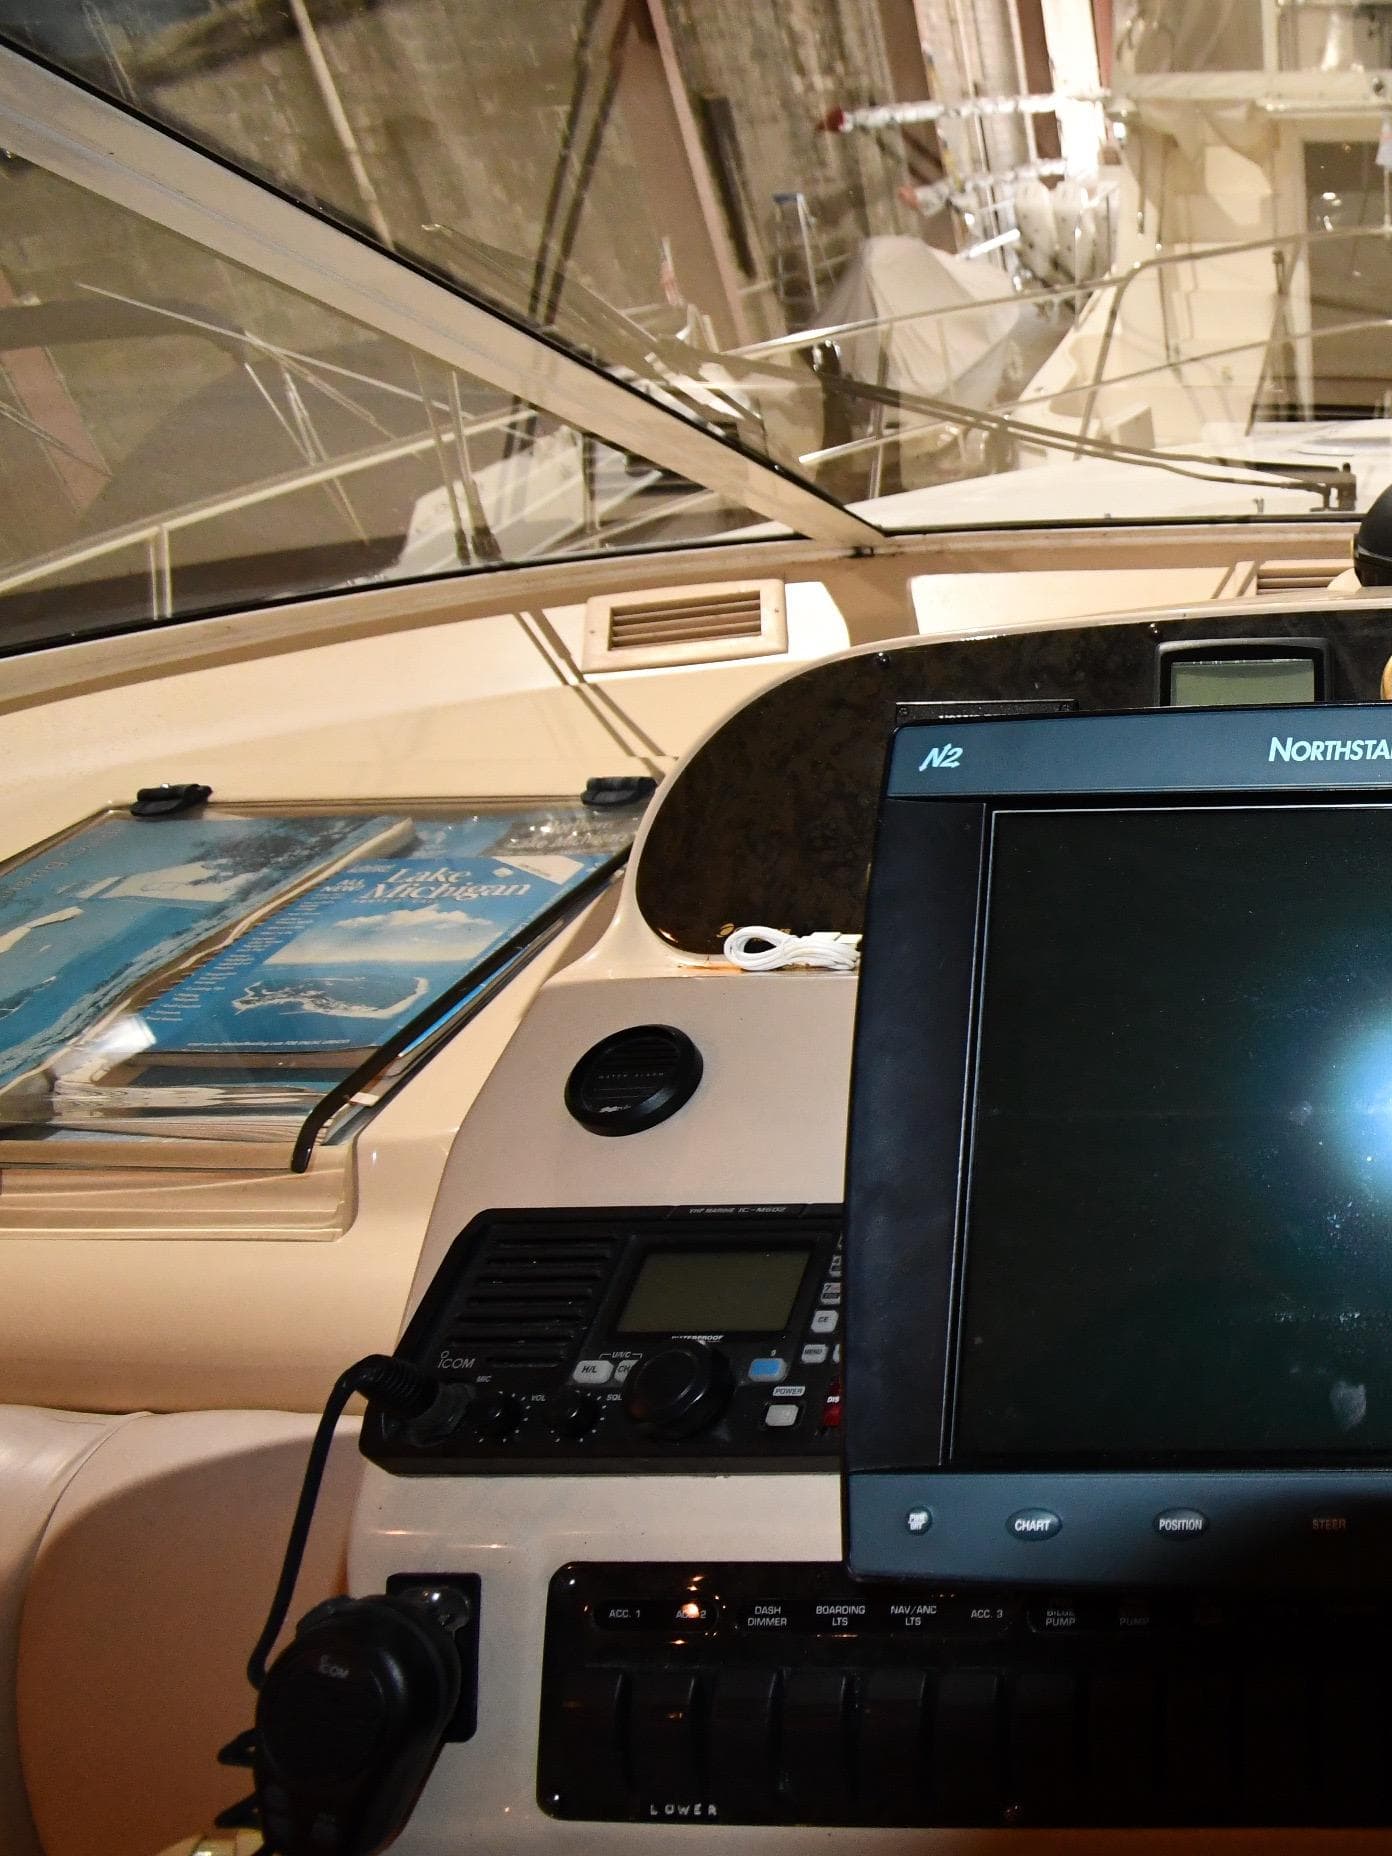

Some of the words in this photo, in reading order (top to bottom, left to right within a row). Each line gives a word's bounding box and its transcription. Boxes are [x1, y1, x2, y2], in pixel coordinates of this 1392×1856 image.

[383, 867, 471, 884] Lake
[359, 882, 532, 901] Michigan
[438, 1352, 476, 1368] ICOM
[581, 1366, 597, 1374] H/L
[1014, 1519, 1051, 1532] CHART
[1158, 1518, 1203, 1532] POSITION
[1312, 1518, 1346, 1531] STEER
[609, 1610, 632, 1618] ACC.
[636, 1609, 641, 1618] 1
[700, 1610, 706, 1618] 2
[754, 1606, 782, 1615] DASH
[816, 1605, 866, 1615] BOARDING
[890, 1606, 938, 1615] NAV/ANC
[971, 1609, 994, 1619] ACC.
[996, 1609, 1004, 1618] 3
[748, 1617, 788, 1627] DIMMER
[832, 1617, 848, 1626] LTS
[905, 1616, 922, 1626] LTS
[1046, 1618, 1076, 1627] PUMP
[650, 1804, 718, 1816] LOWER
